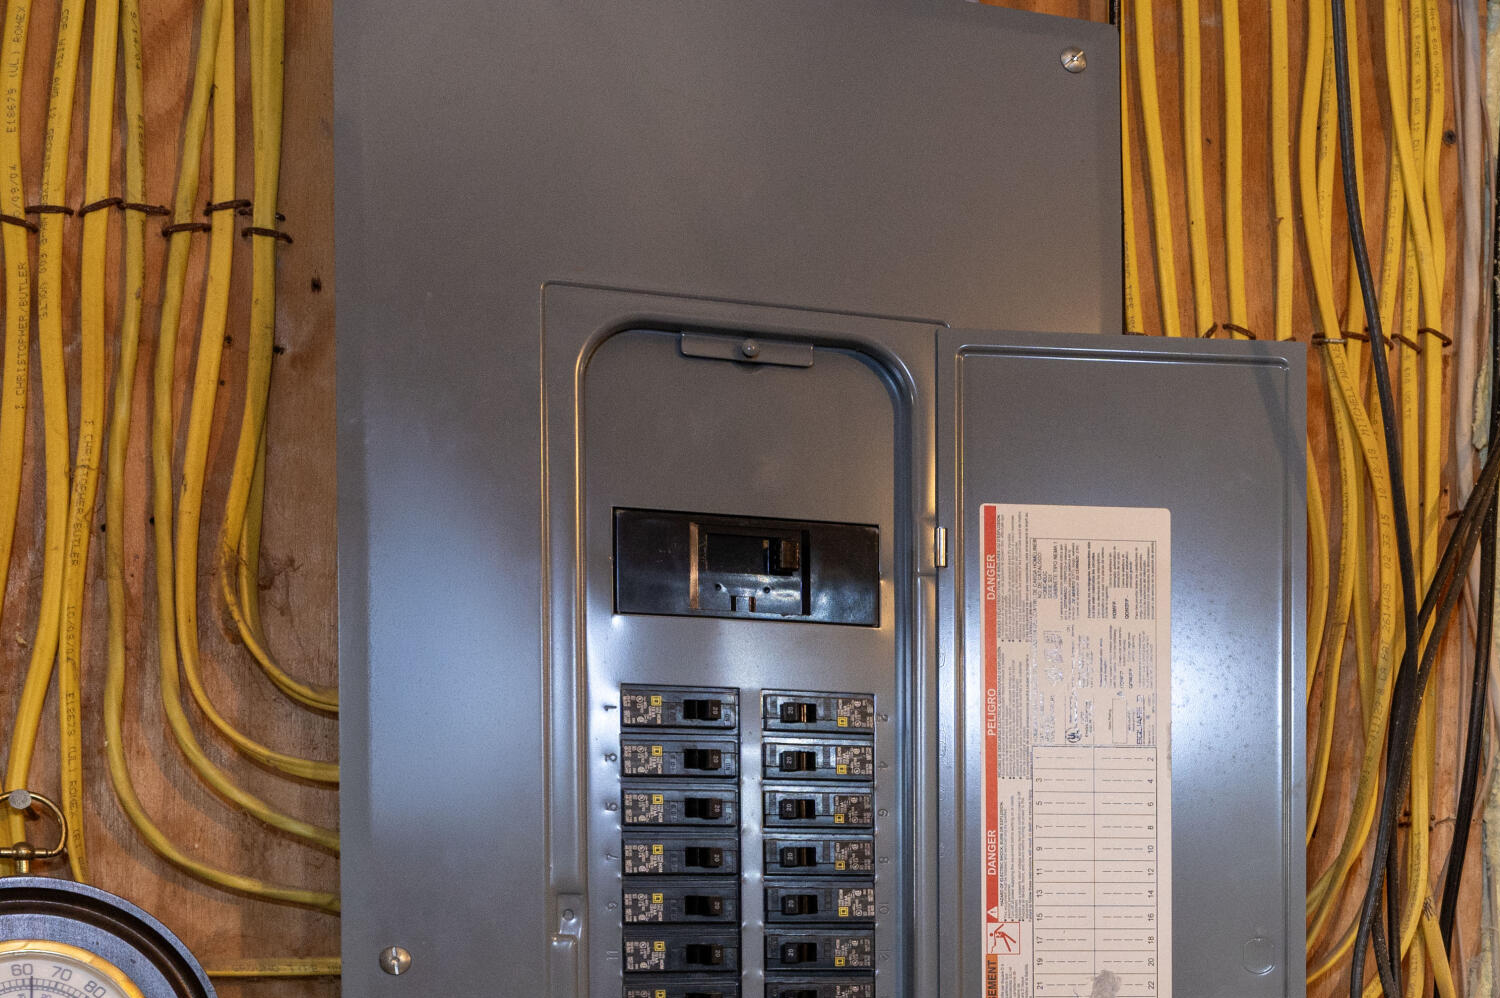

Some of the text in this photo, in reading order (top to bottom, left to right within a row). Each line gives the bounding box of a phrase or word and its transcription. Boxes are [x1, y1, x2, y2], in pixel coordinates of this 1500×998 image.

[13, 6, 26, 44] ROMEX
[987, 554, 996, 600] DANGER
[987, 688, 996, 736] PELIGRO
[988, 830, 996, 876] DANGER
[1148, 844, 1155, 853] 10
[1148, 868, 1155, 877] 12
[1036, 890, 1043, 898] 13
[1148, 889, 1155, 898] 14
[1036, 913, 1043, 921] 15
[1148, 936, 1154, 944] 18
[1148, 958, 1155, 966] 20
[11, 964, 34, 976] 60
[51, 965, 72, 981] 70
[84, 980, 107, 998] 80
[1148, 981, 1154, 989] 22
